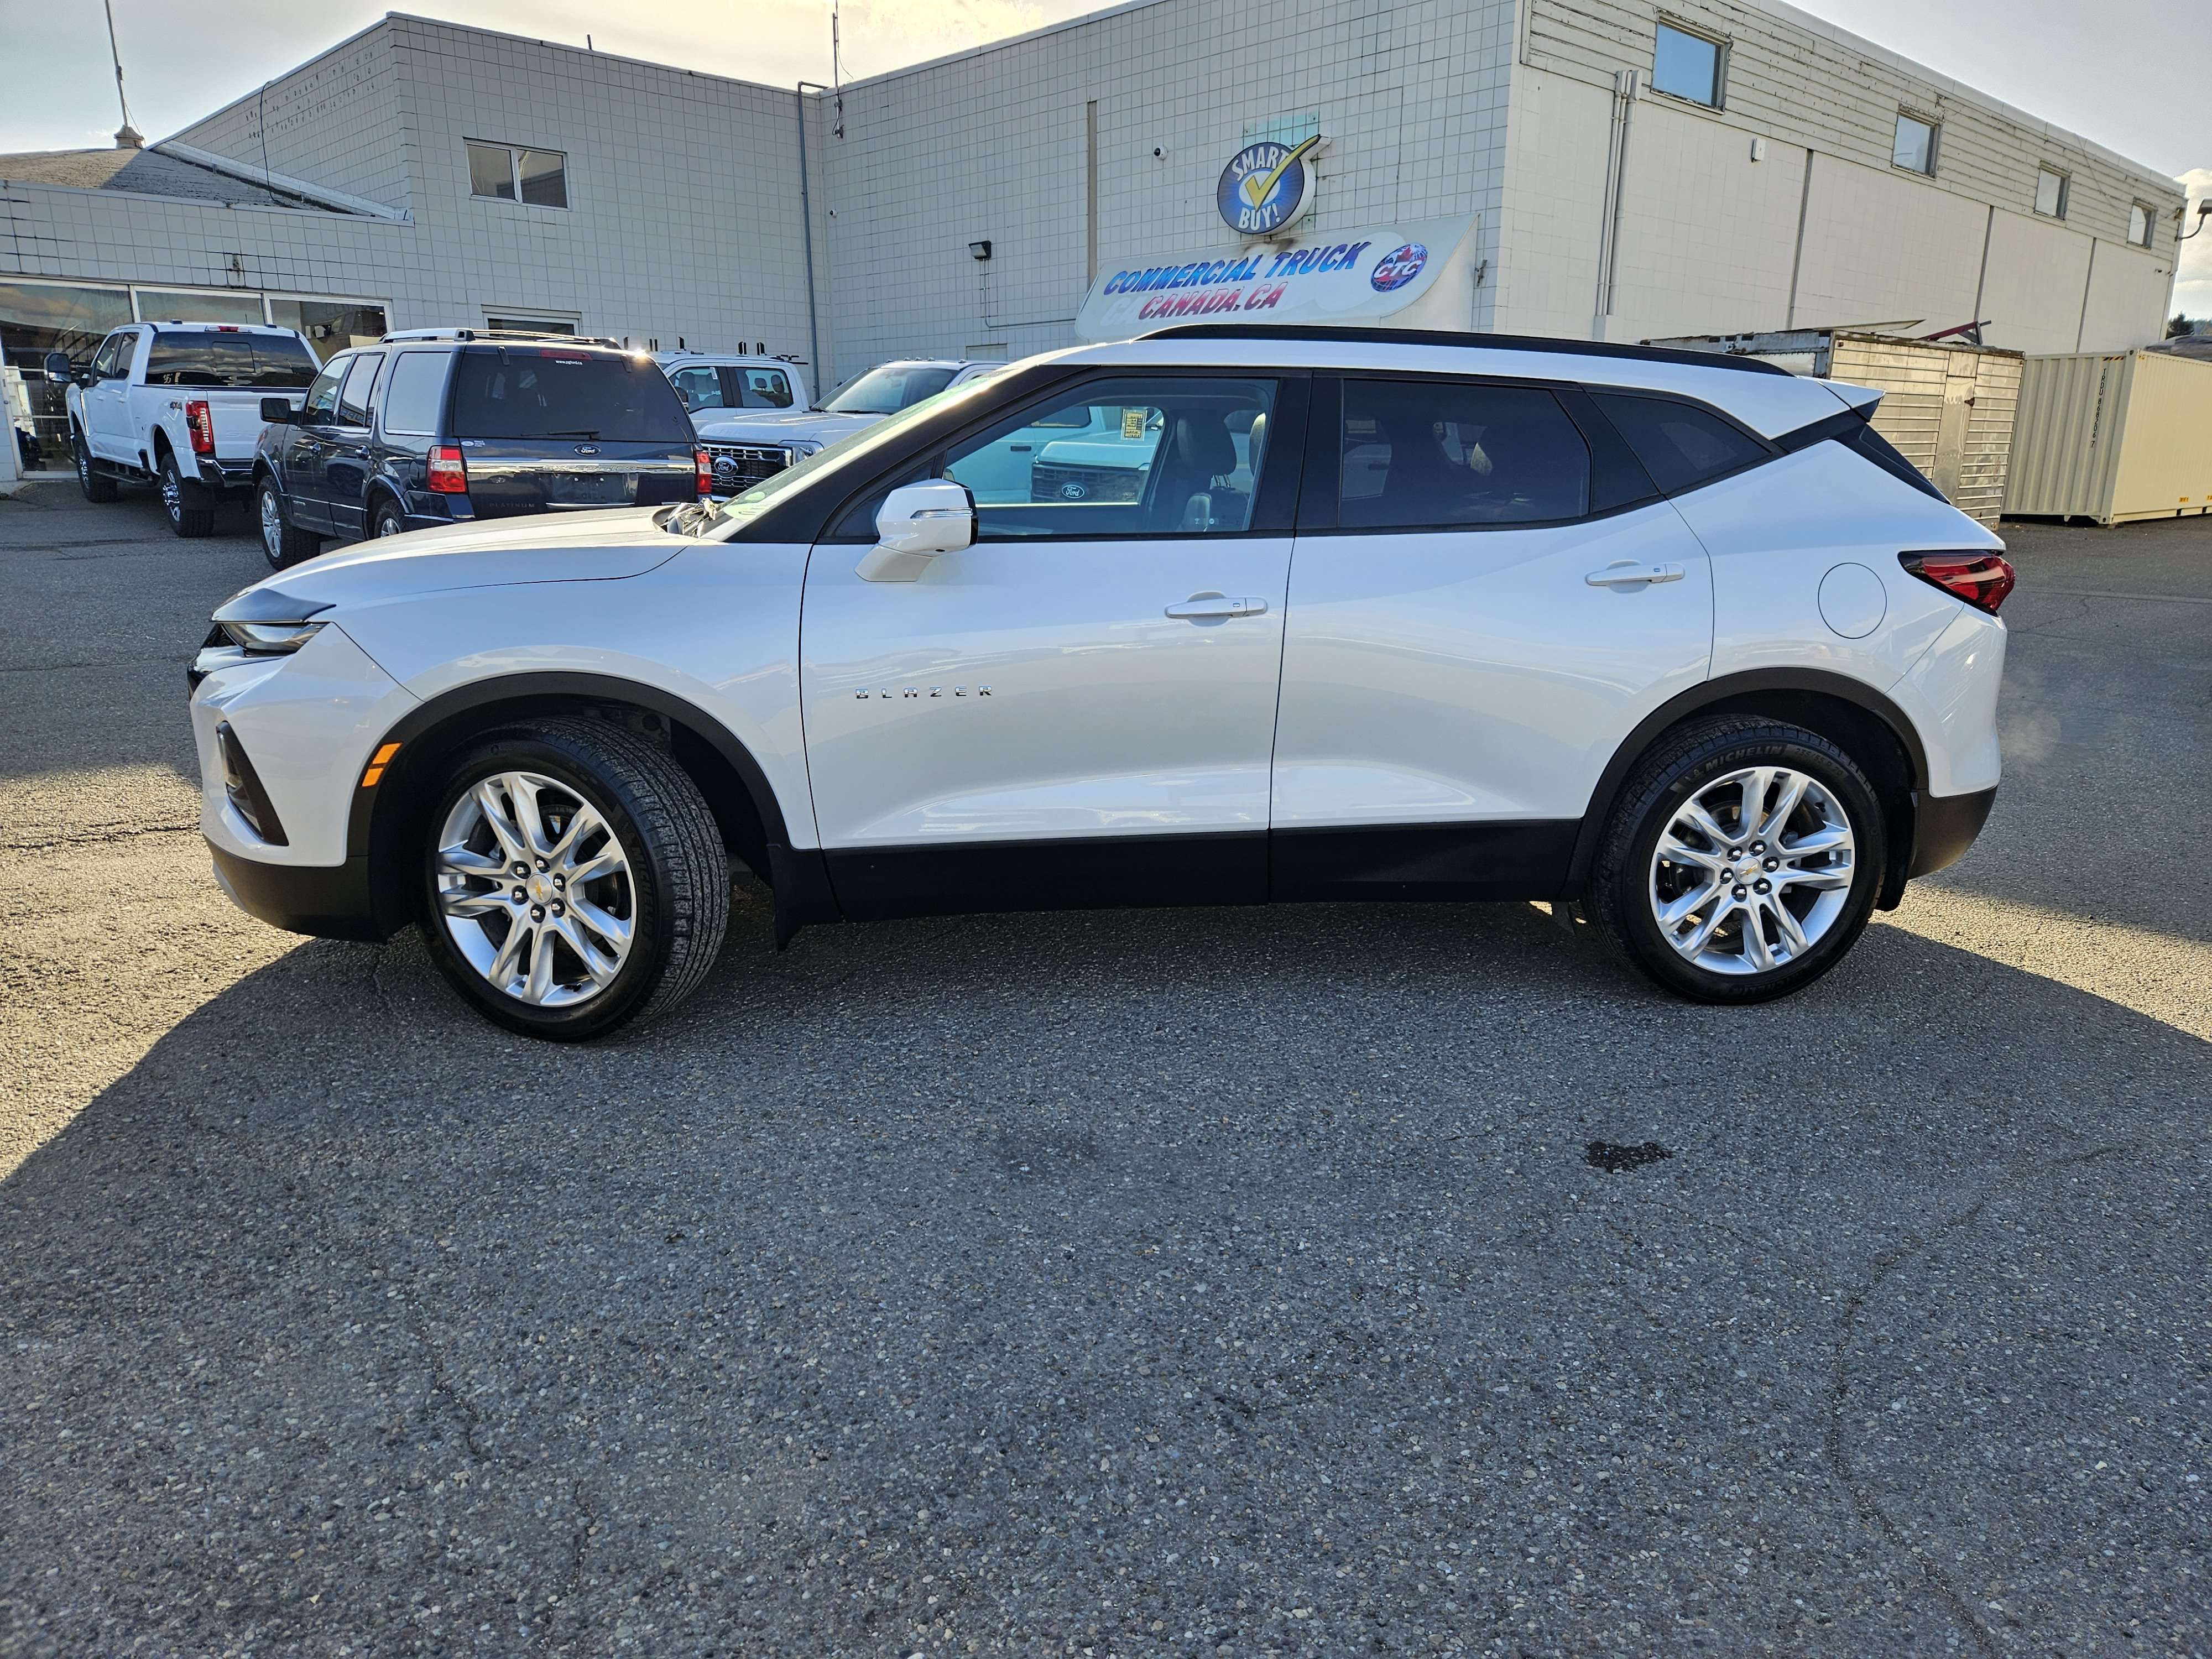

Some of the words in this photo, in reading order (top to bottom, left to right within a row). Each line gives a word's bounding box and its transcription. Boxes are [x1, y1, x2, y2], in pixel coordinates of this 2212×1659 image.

[1232, 146, 1290, 181] SMART
[1238, 202, 1280, 231] BUY!
[1103, 254, 1264, 295] COMMERCIAL
[1264, 241, 1371, 279] TRUCK
[1374, 260, 1422, 278] CTC
[1138, 281, 1288, 320] CANADA.CA
[717, 462, 729, 471] Ford
[1065, 486, 1080, 497] Ford
[855, 685, 992, 699] BLAZER
[1705, 745, 1783, 771] MICHELIN
